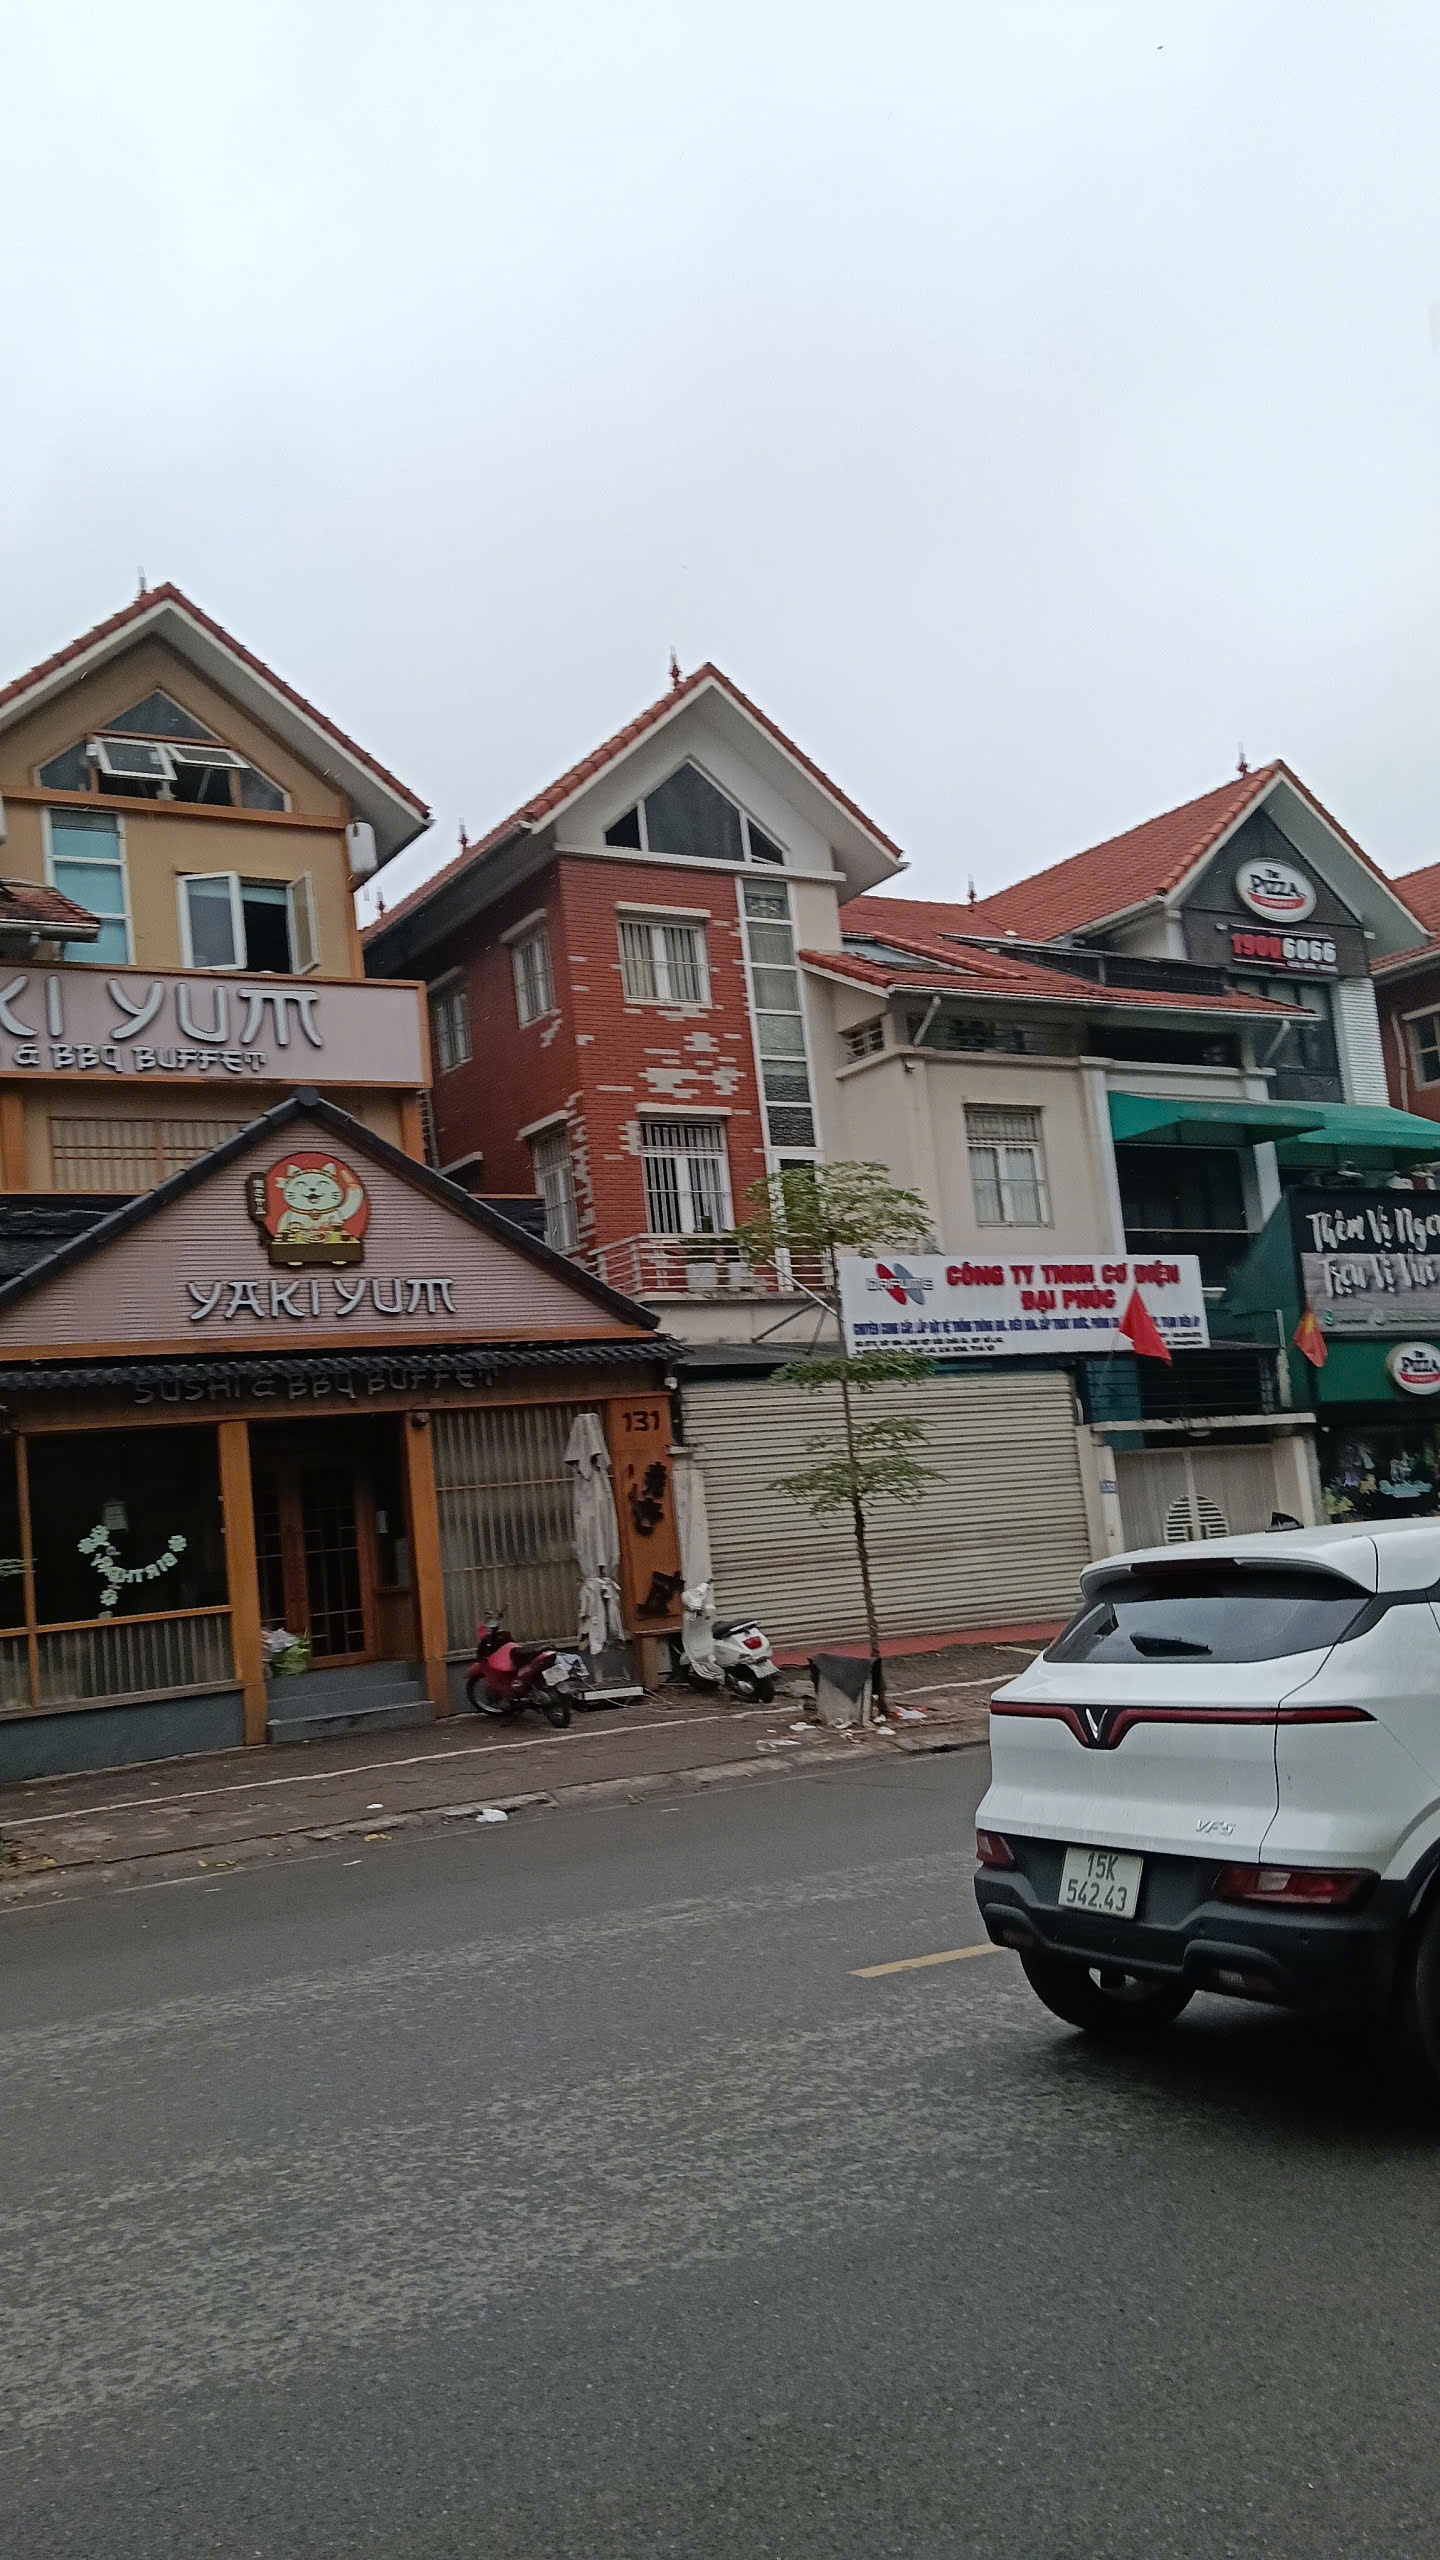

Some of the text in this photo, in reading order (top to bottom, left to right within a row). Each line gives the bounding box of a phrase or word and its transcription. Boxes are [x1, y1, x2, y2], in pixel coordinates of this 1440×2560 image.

[1248, 873, 1306, 898] PIZZA
[106, 978, 325, 1047] YUM
[49, 1042, 124, 1073] BBQ
[132, 1045, 267, 1073] BUFFET
[946, 1261, 1006, 1287] CÔNG
[1009, 1264, 1034, 1286] TY
[186, 1277, 457, 1320] YAKI YUM
[134, 1375, 241, 1403] SUSHI
[621, 1409, 661, 1433] 131
[1087, 1851, 1120, 1882] 15K
[1066, 1878, 1128, 1913] 542.43
